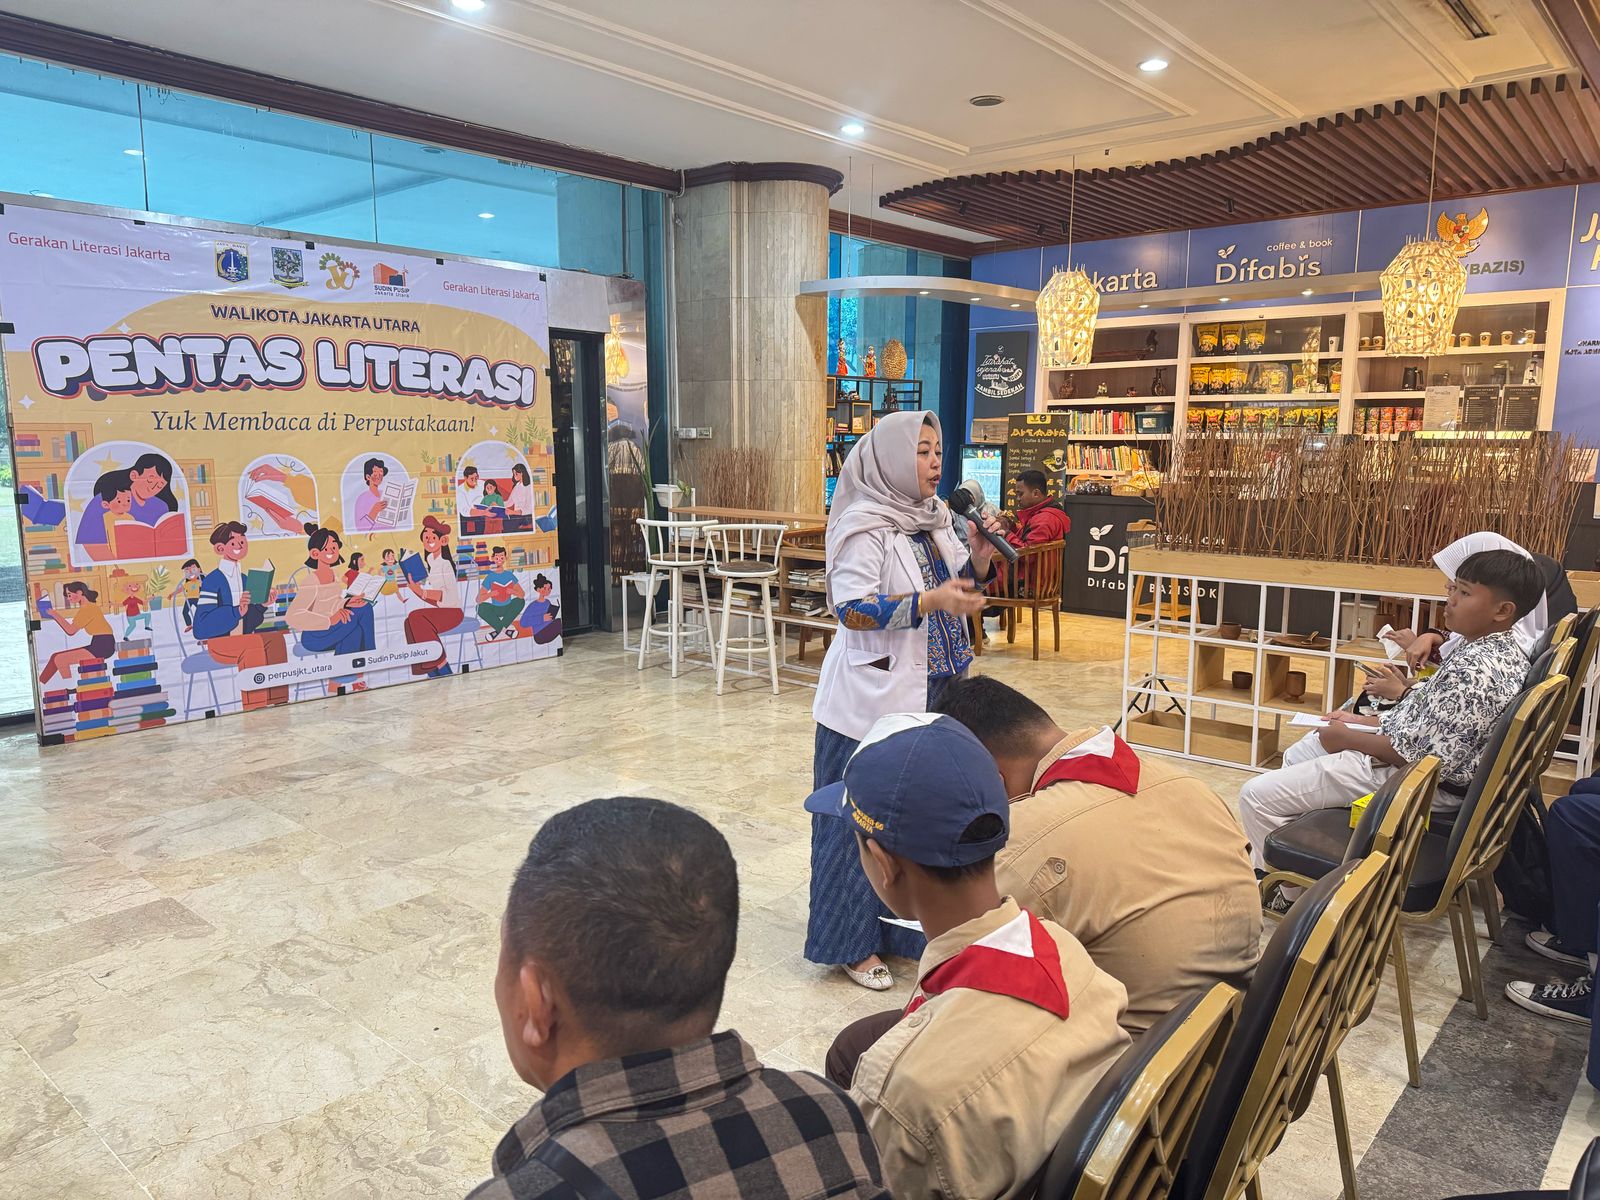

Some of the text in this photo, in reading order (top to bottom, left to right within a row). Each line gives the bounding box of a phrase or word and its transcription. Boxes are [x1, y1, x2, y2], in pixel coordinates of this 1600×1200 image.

[8, 232, 171, 262] Gerakan Literasi Jakarta
[1266, 238, 1333, 252] coffee & book
[1215, 253, 1321, 284] Difabis
[1465, 260, 1525, 275] (BAZIS)
[443, 281, 540, 301] Gerakan Literasi Jakarta
[1093, 268, 1158, 293] karta
[210, 304, 420, 333] WALIKOTA JAKARTA UTARA
[33, 333, 536, 409] PENTAS LITERASI
[976, 383, 1024, 396] SAMBIL SEDEKAH
[151, 410, 476, 437] Yuk Membaca di Perpustakaan!
[1087, 577, 1126, 591] Difab
[1197, 588, 1217, 598] DK
[367, 649, 429, 665] Sudin Pusip Jakut
[267, 663, 333, 682] perpusjkt_utara
